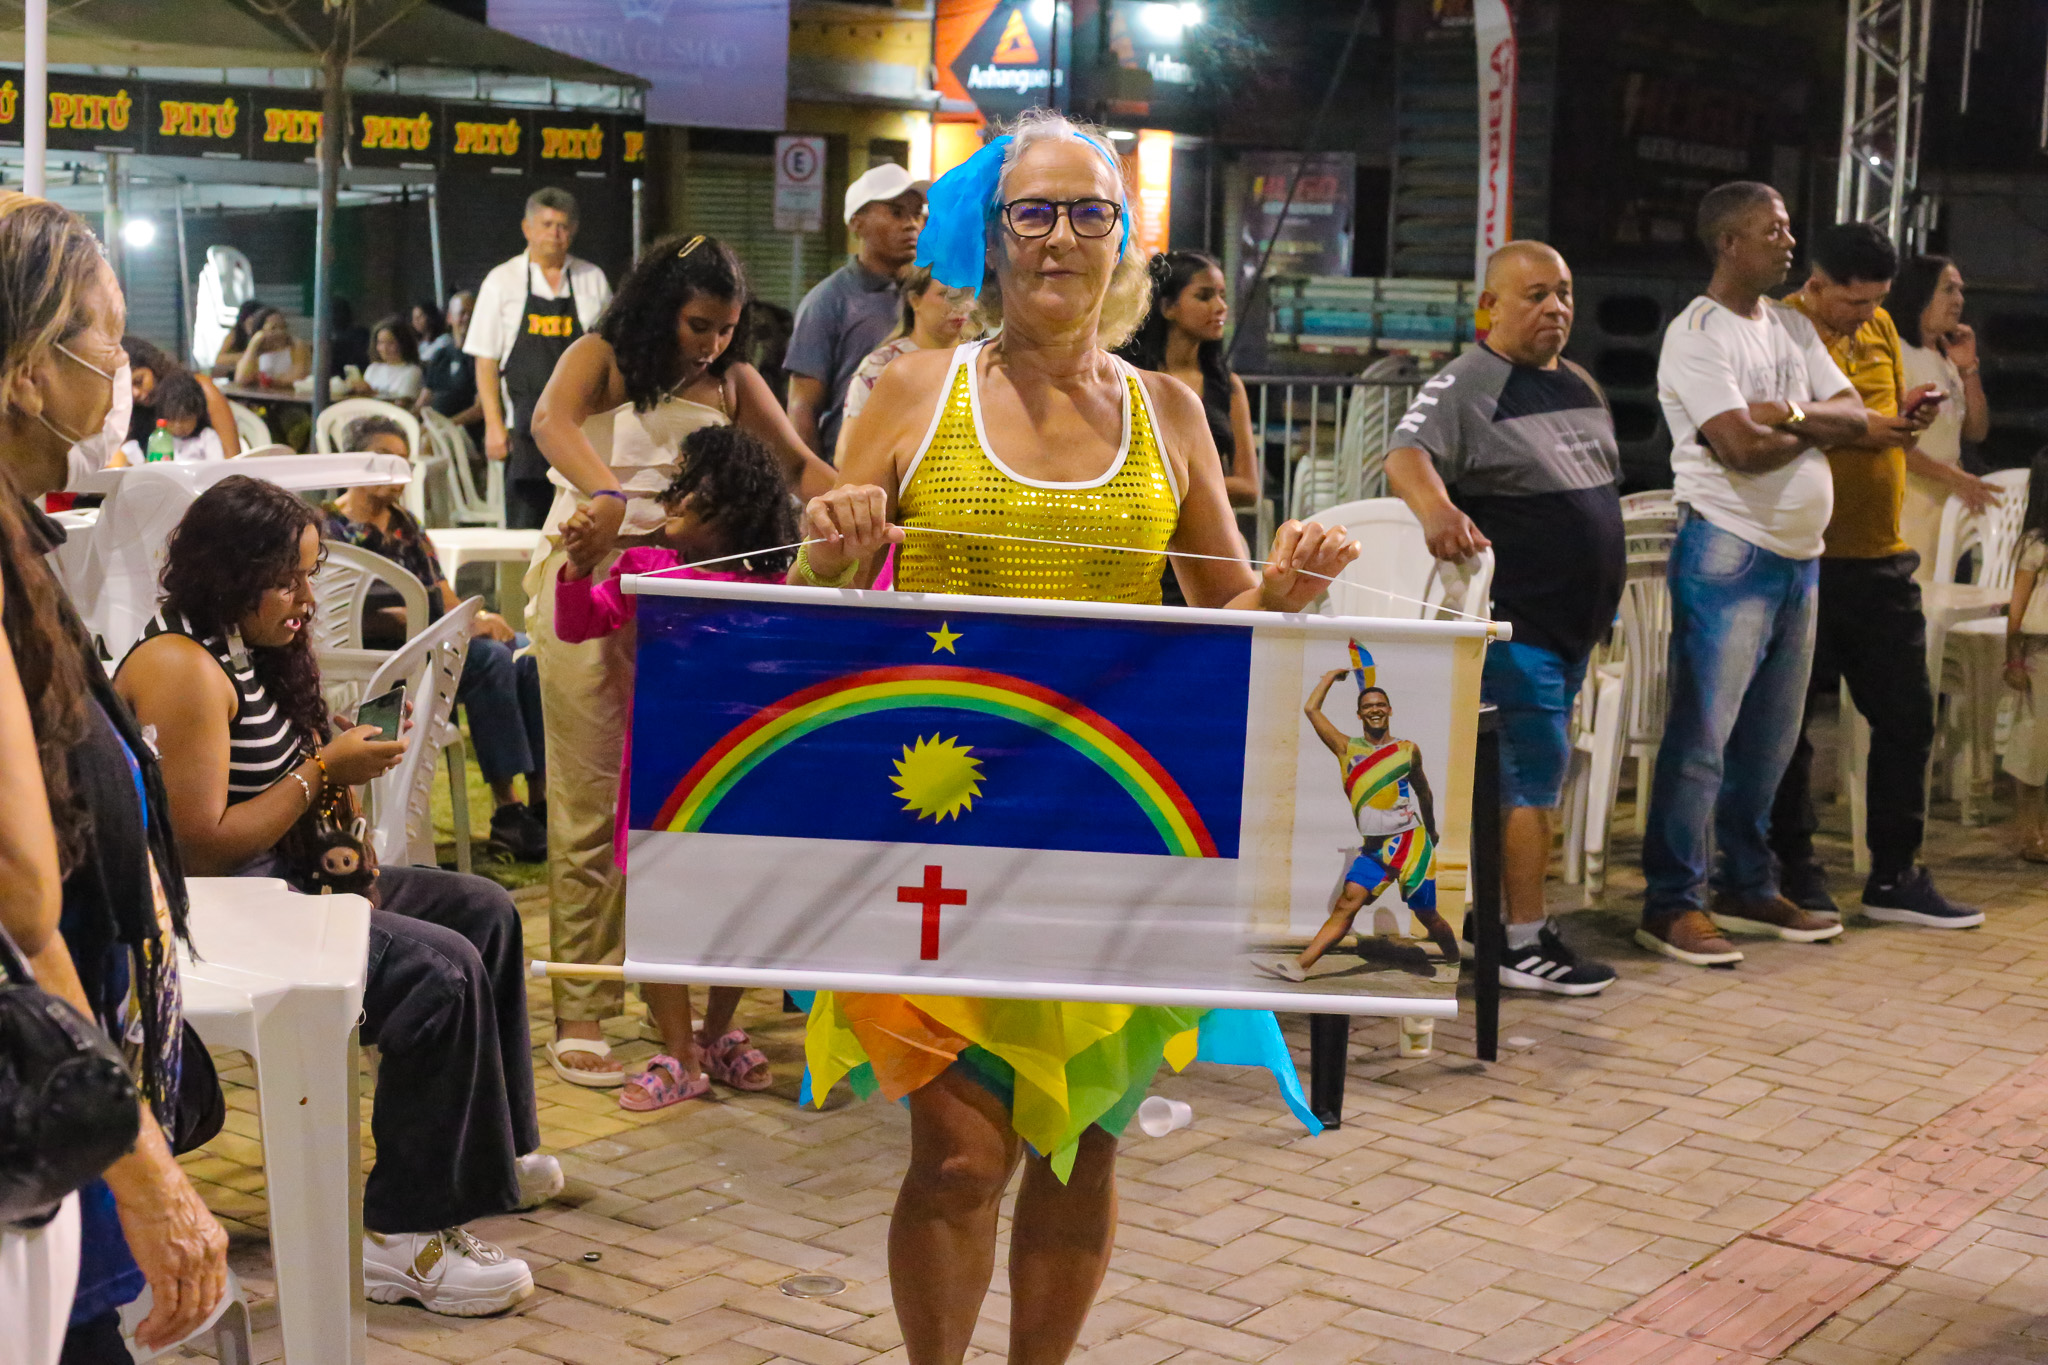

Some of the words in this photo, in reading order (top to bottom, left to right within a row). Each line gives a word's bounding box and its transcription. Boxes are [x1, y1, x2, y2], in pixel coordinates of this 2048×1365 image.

[967, 63, 1064, 95] Anhanguea
[49, 88, 132, 131] PITÚ
[160, 98, 238, 138] PITÚ
[264, 108, 323, 143] PIT
[362, 112, 432, 150] PITÚ
[454, 118, 521, 155] PITÚ
[541, 123, 603, 160] PITÚ
[794, 151, 804, 173] E
